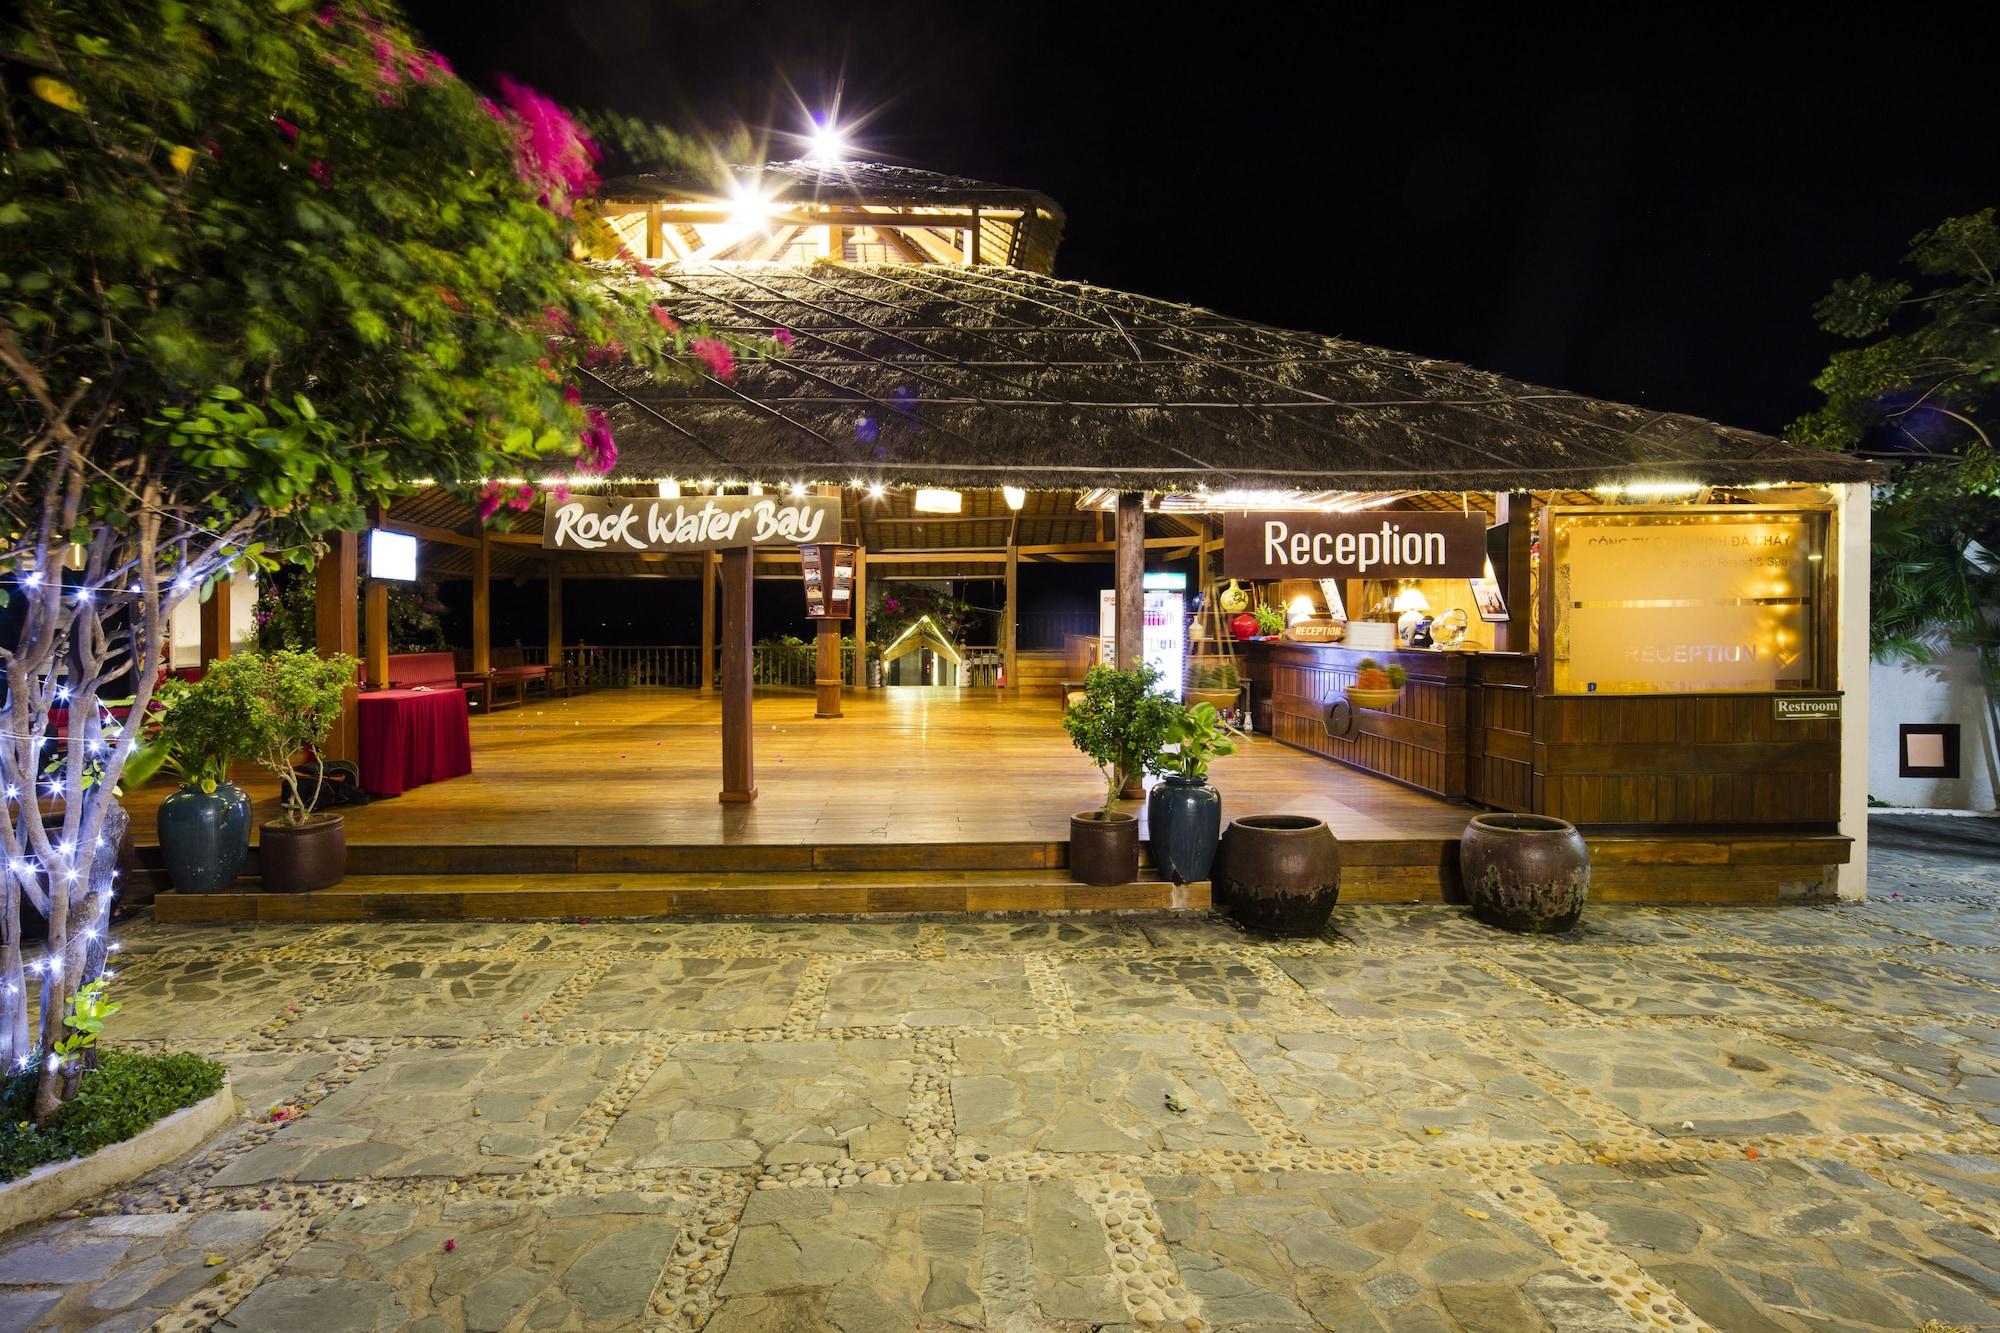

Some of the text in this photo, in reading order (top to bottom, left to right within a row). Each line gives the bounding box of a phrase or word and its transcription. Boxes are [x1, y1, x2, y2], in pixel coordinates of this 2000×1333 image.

[555, 500, 825, 549] Rock Water Bay
[1264, 520, 1446, 573] Reception
[1294, 624, 1342, 636] RECEPTION
[1624, 644, 1757, 664] RECEPTION
[1778, 700, 1838, 712] Restroom
